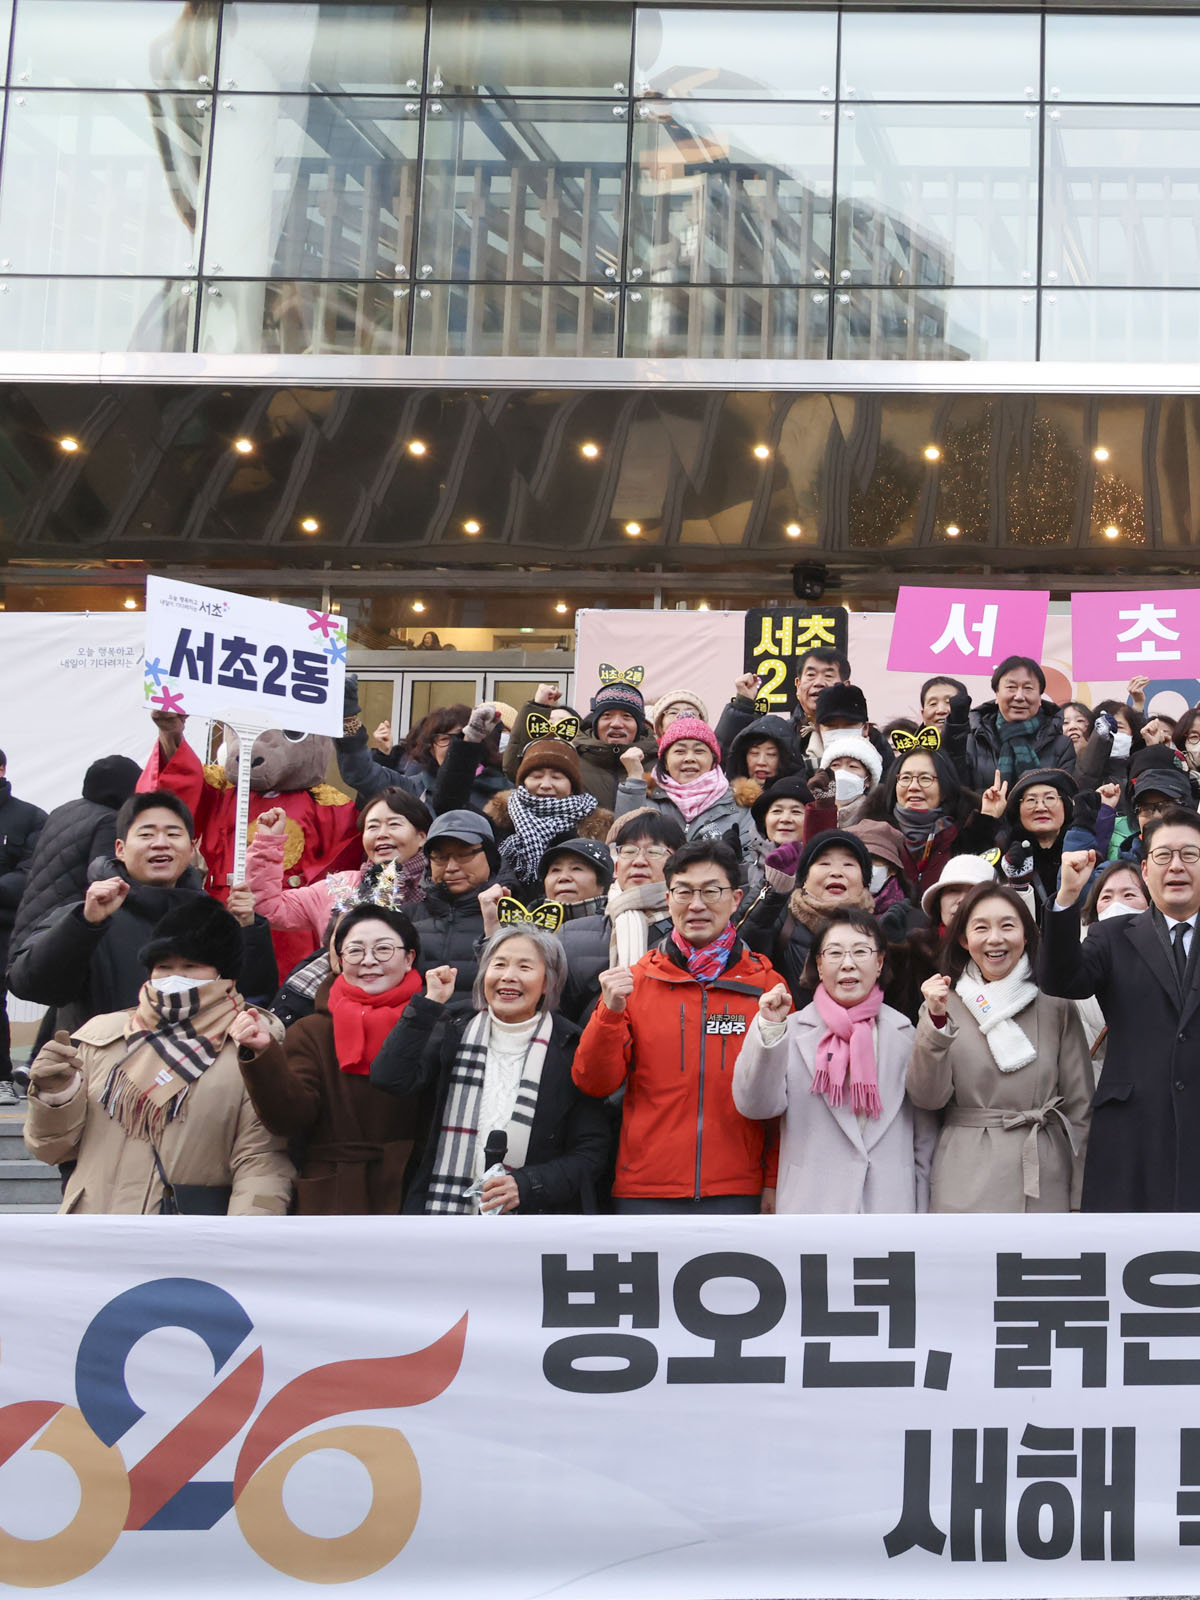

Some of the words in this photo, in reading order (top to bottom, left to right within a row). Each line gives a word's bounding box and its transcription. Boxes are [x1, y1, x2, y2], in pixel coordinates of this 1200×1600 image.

[199, 601, 223, 618] 서초
[753, 614, 837, 656] 서초
[929, 603, 999, 657] 서
[1116, 603, 1182, 662] 초
[169, 628, 329, 704] 서초2동
[706, 1021, 747, 1035] 김성주
[541, 1250, 953, 1394] 병오년,
[882, 1422, 1136, 1563] 새해
